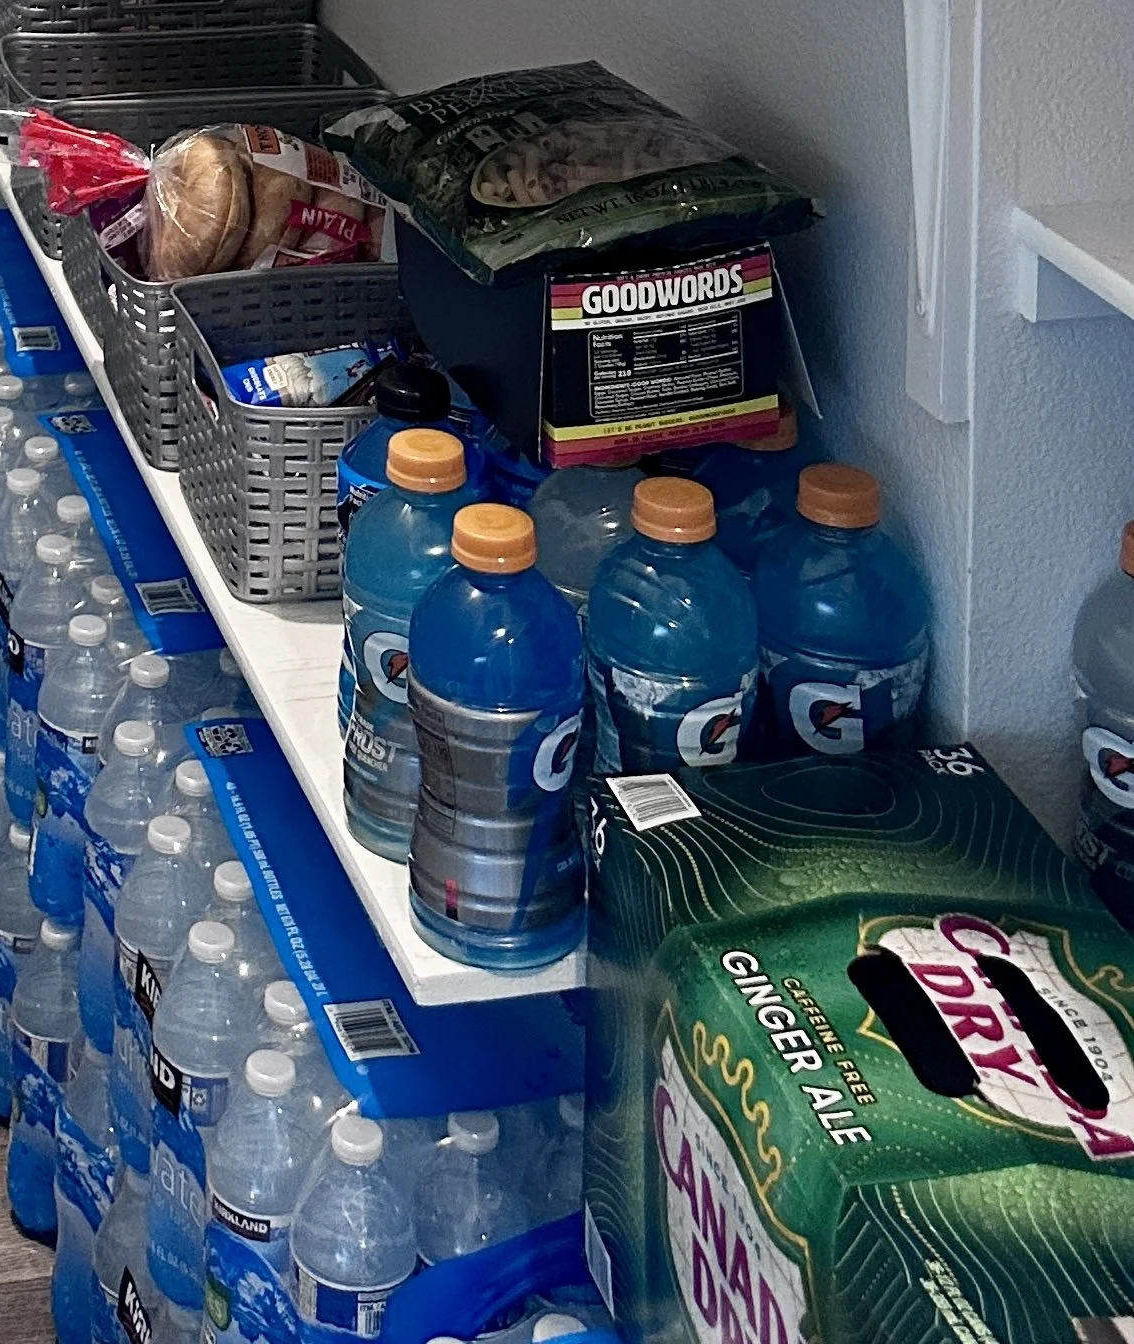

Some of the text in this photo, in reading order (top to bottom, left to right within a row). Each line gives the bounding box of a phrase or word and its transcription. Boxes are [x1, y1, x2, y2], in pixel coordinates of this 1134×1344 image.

[301, 206, 358, 243] PLAIN
[582, 263, 744, 315] GOODWORDS
[363, 631, 410, 703] G
[534, 714, 584, 792] G
[676, 688, 742, 767] G
[790, 681, 865, 754] G
[916, 749, 948, 777] PACK
[933, 745, 975, 778] 36
[721, 949, 873, 1147] GINGER ALE
[781, 977, 878, 1106] CAFFEINE FREE
[907, 962, 1040, 1088] DRY
[1039, 986, 1115, 1083] SINCE 1904
